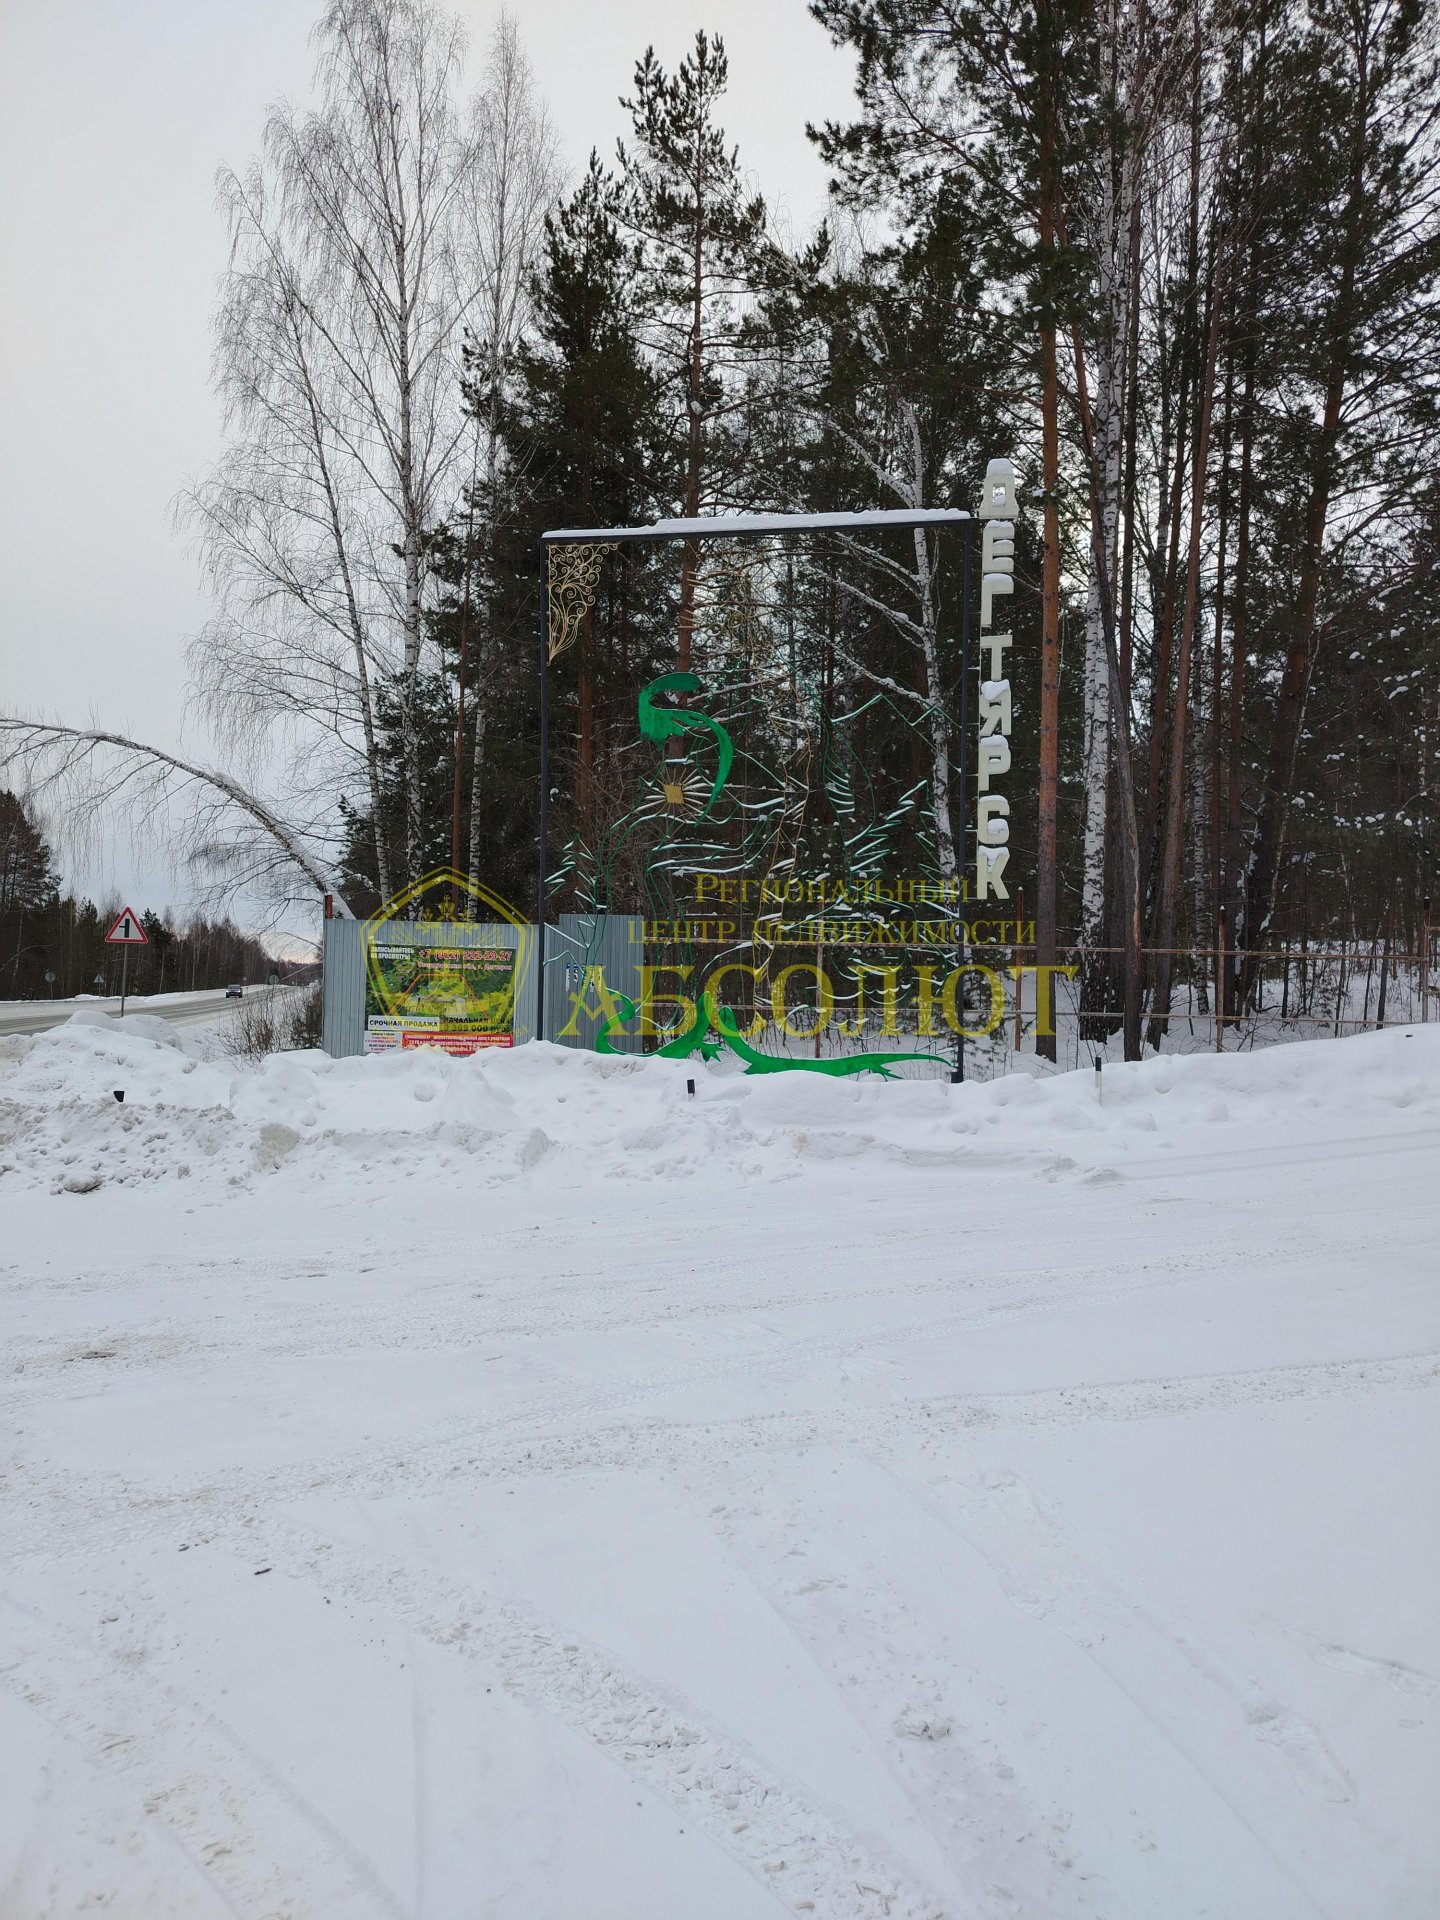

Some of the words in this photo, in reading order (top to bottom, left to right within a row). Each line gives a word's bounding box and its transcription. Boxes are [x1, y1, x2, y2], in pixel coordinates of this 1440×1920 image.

[976, 470, 1019, 900] ДЕГТЯРСК
[444, 1016, 489, 1024] НАЧАЛЬНАЯ
[471, 1024, 489, 1032] 000
